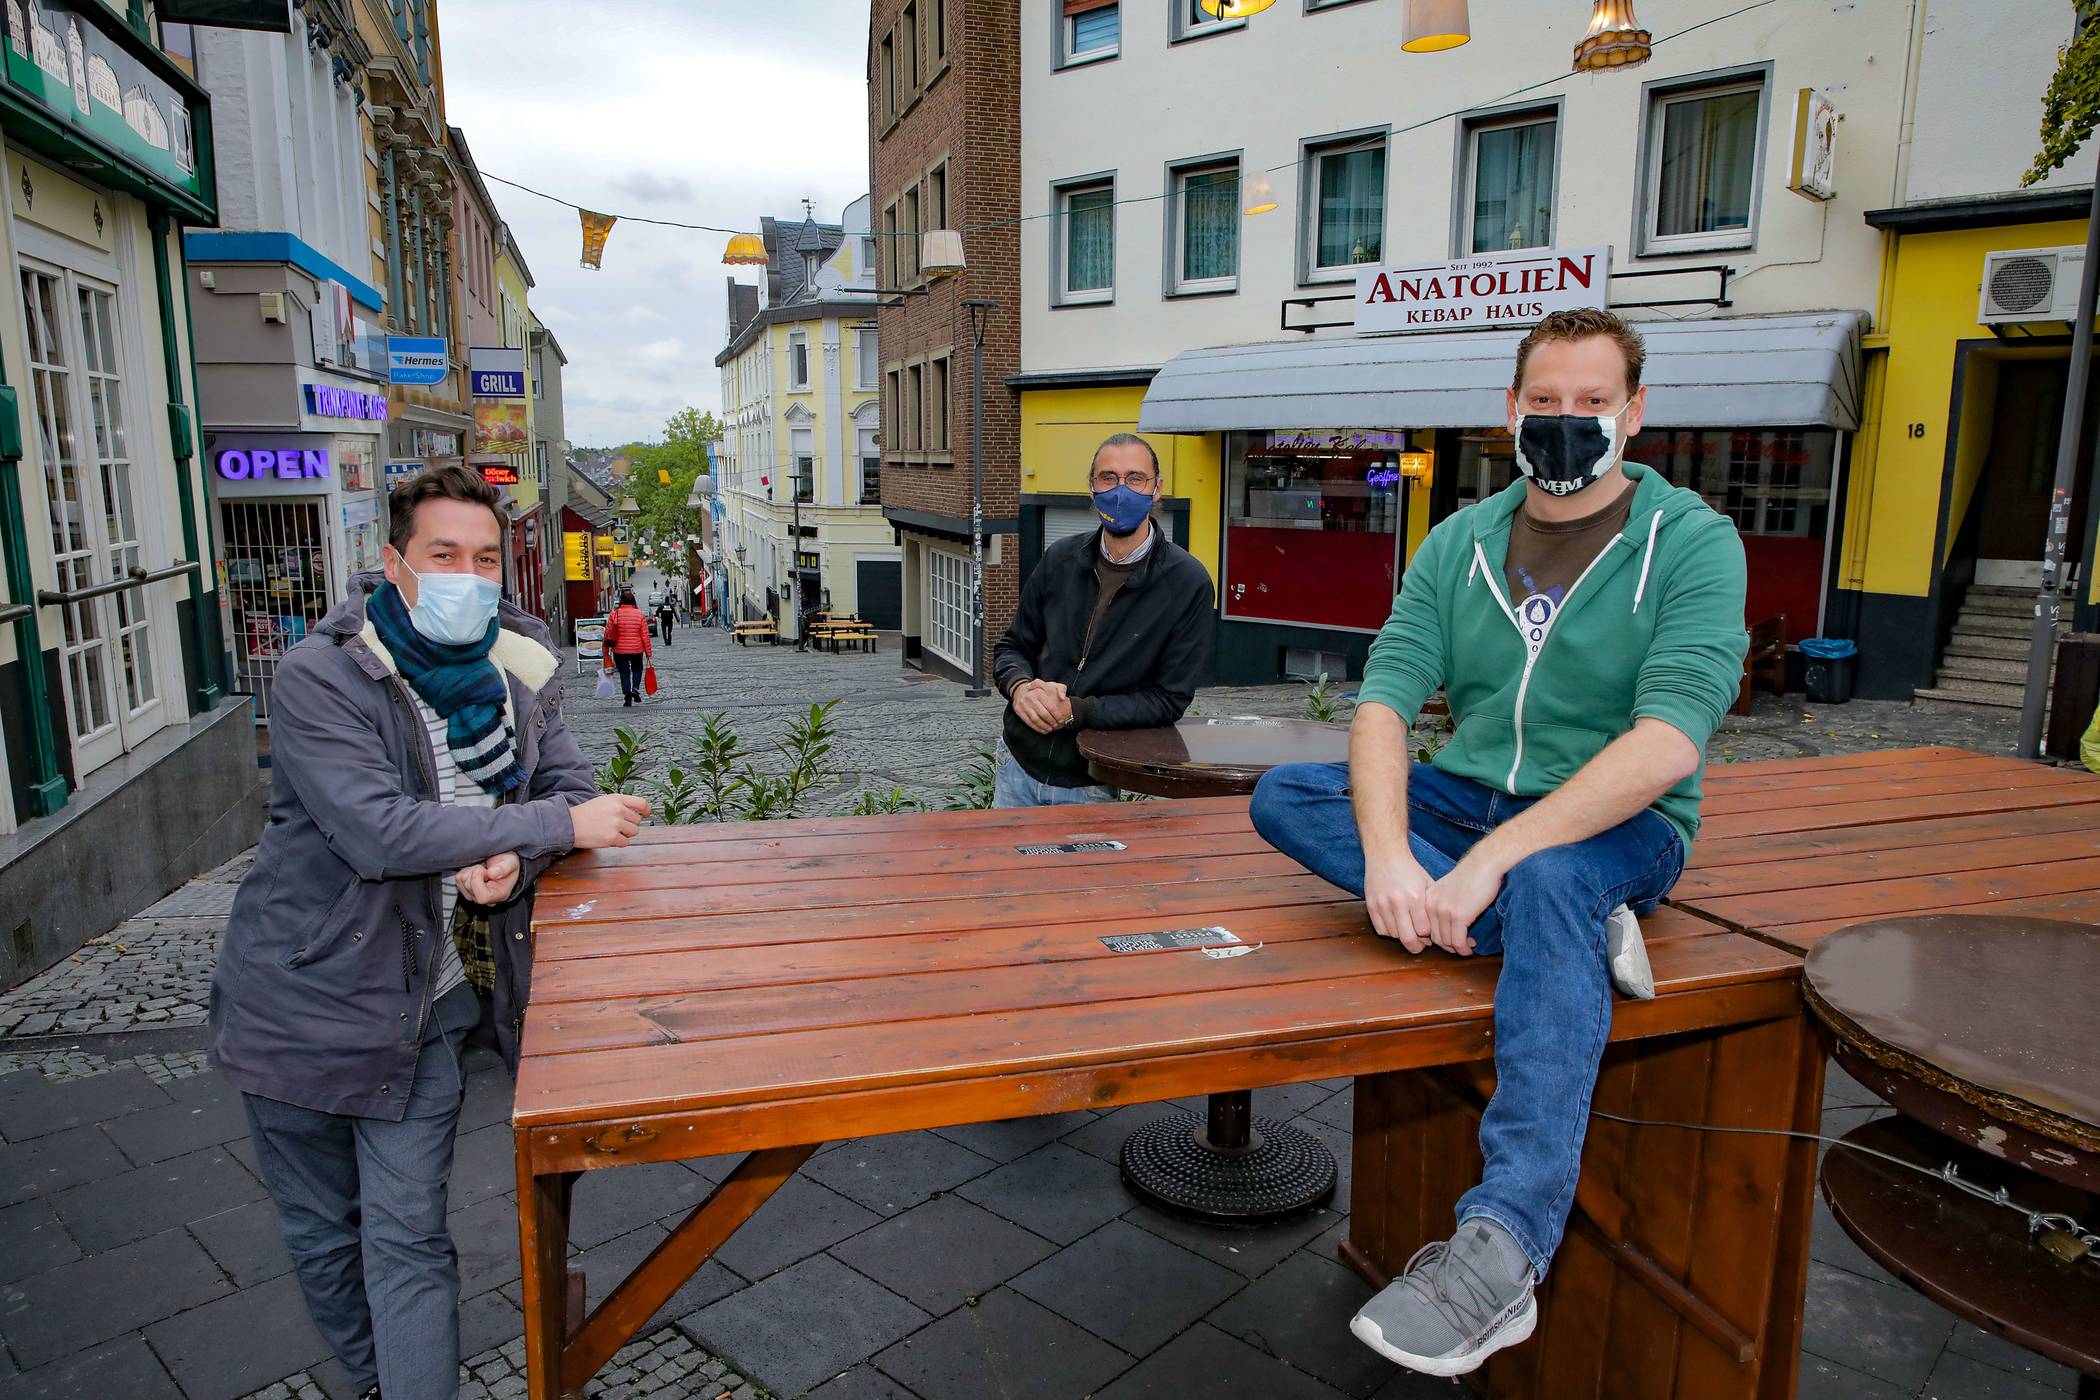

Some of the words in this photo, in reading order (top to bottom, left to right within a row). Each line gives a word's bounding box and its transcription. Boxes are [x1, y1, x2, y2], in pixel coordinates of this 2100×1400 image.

[1472, 262, 1493, 270] 1992
[1366, 255, 1595, 304] ANATOLIEN
[1406, 307, 1473, 324] KEBAP
[1486, 302, 1543, 320] HAUS
[404, 356, 444, 366] Hermes
[480, 374, 517, 393] GRILL
[315, 384, 365, 418] TRINKPUNKT
[1908, 423, 1925, 439] 18
[217, 449, 330, 480] OPEN
[1476, 1316, 1504, 1348] BRITISH
